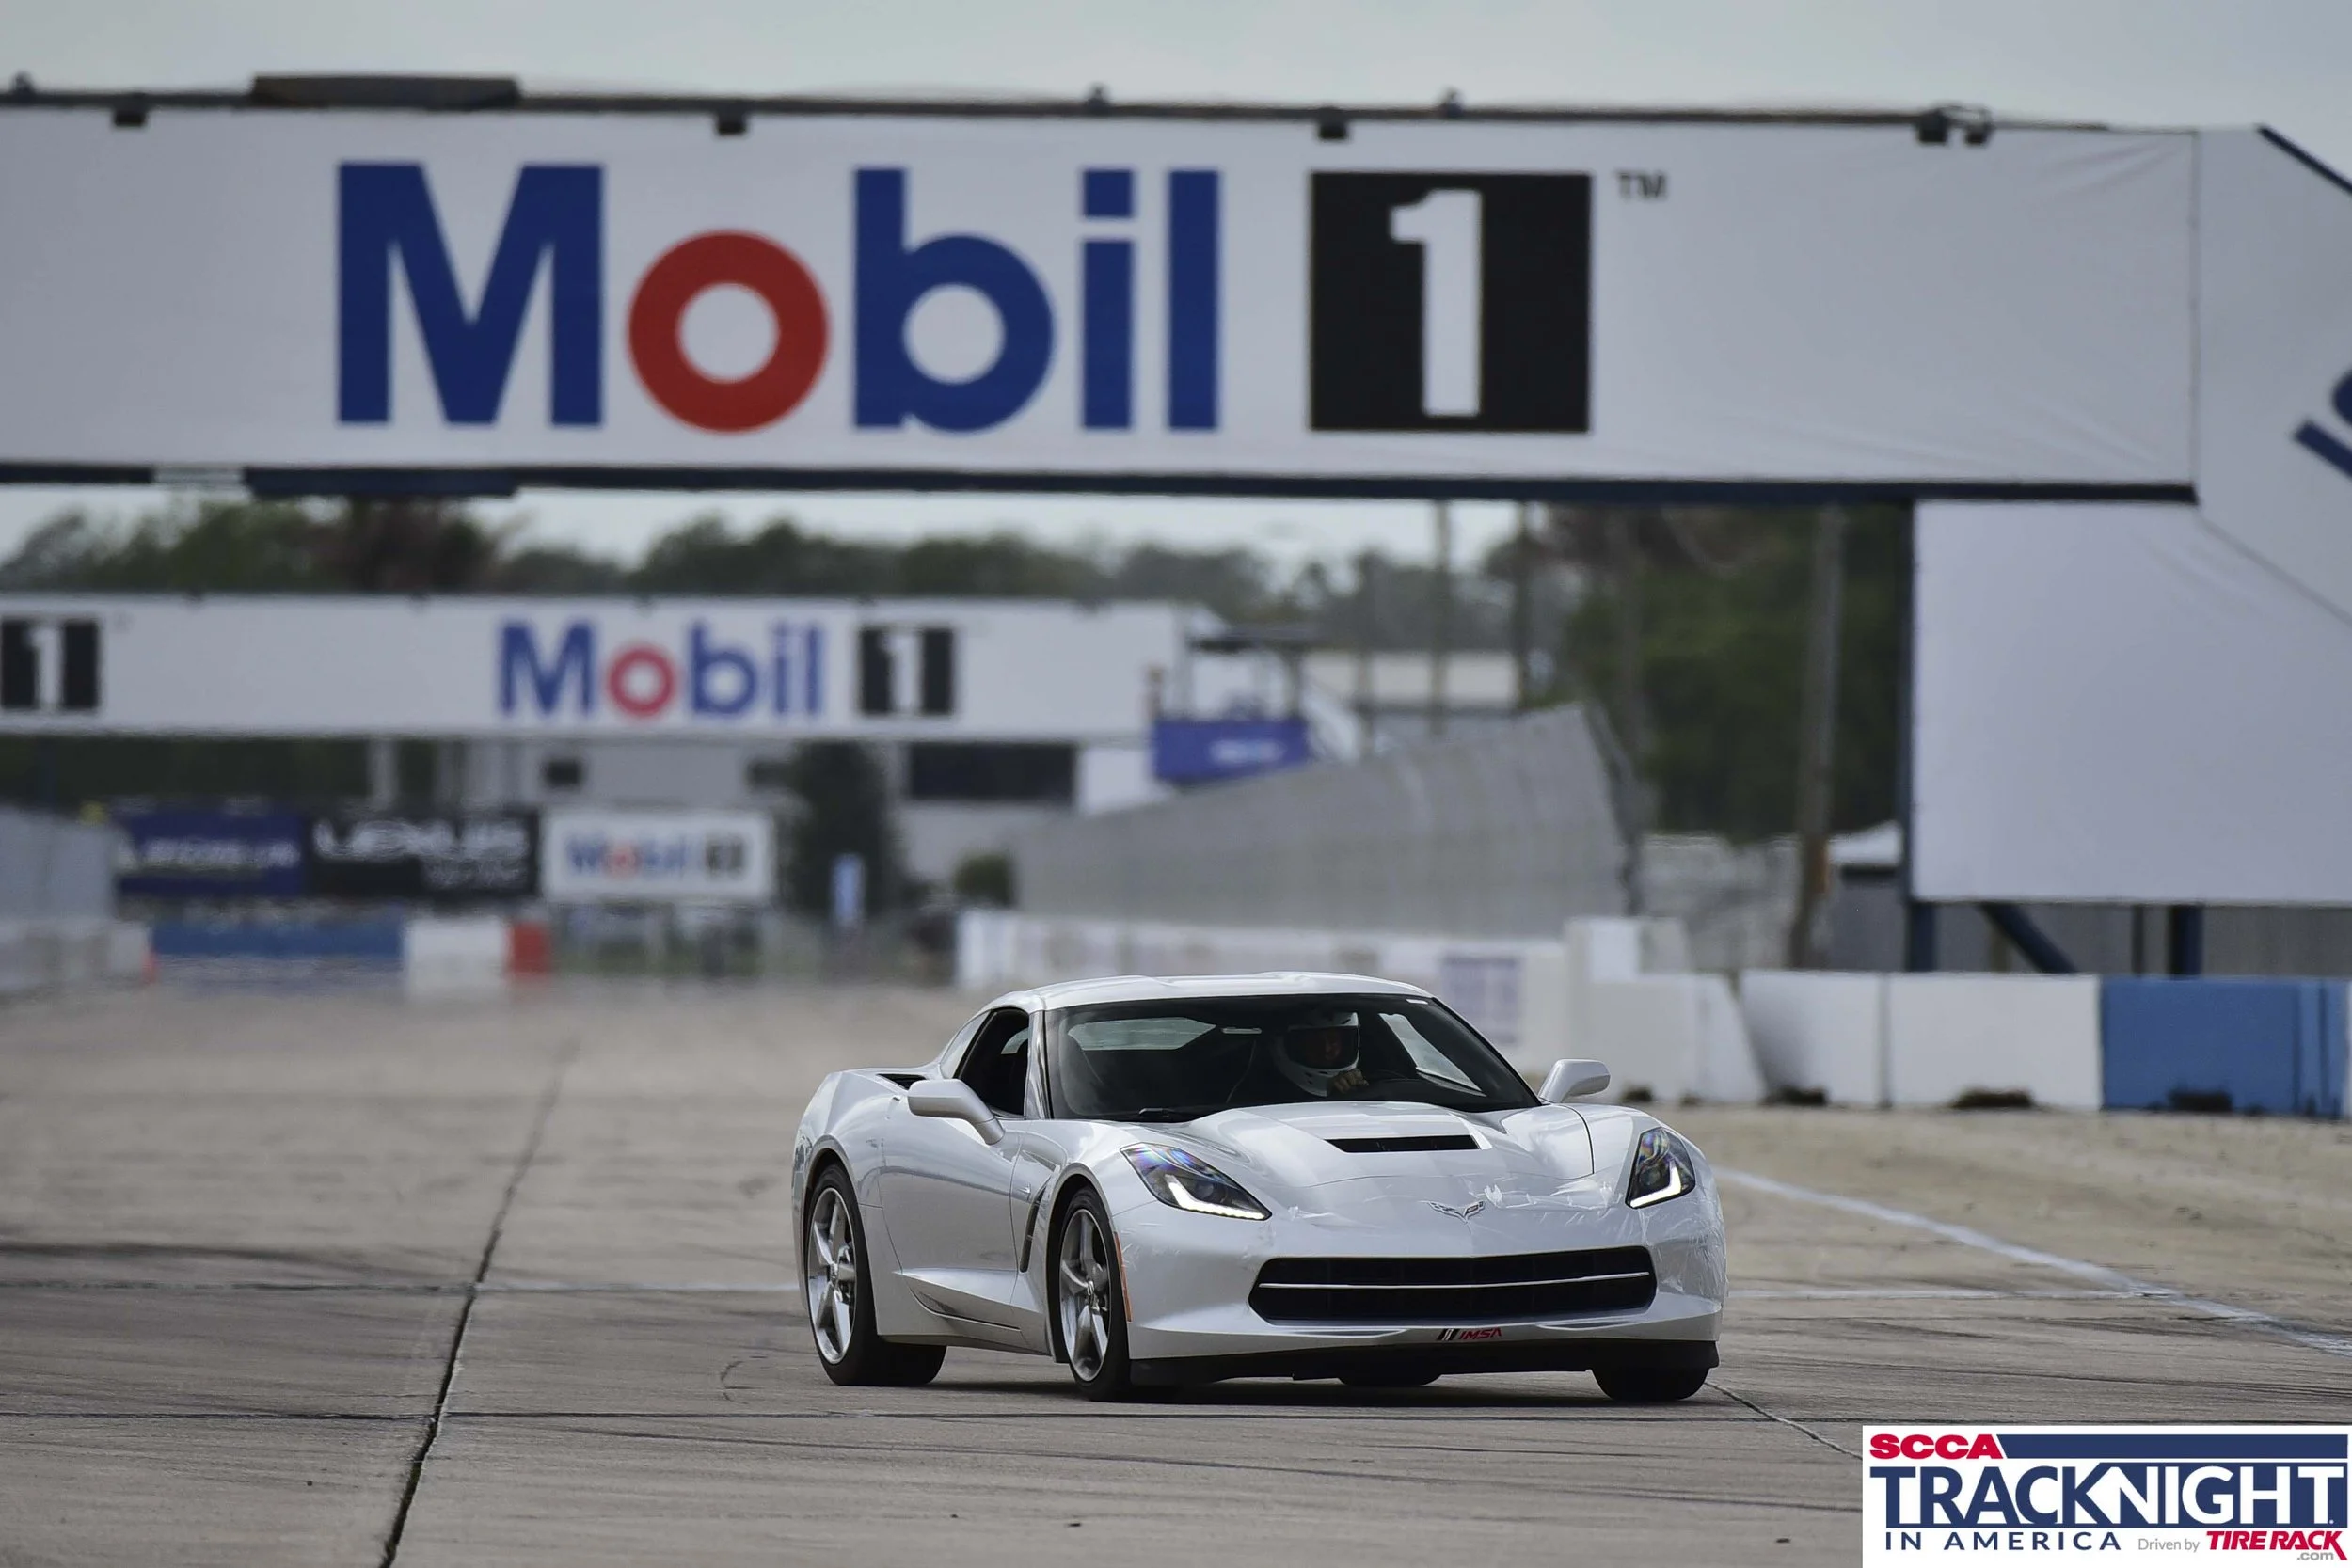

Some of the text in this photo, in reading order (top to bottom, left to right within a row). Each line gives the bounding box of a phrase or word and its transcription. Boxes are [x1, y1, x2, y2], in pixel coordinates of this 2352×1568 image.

[337, 163, 1219, 434] Mobil
[499, 621, 824, 720] Mobil
[1458, 1326, 1502, 1340] IMSA
